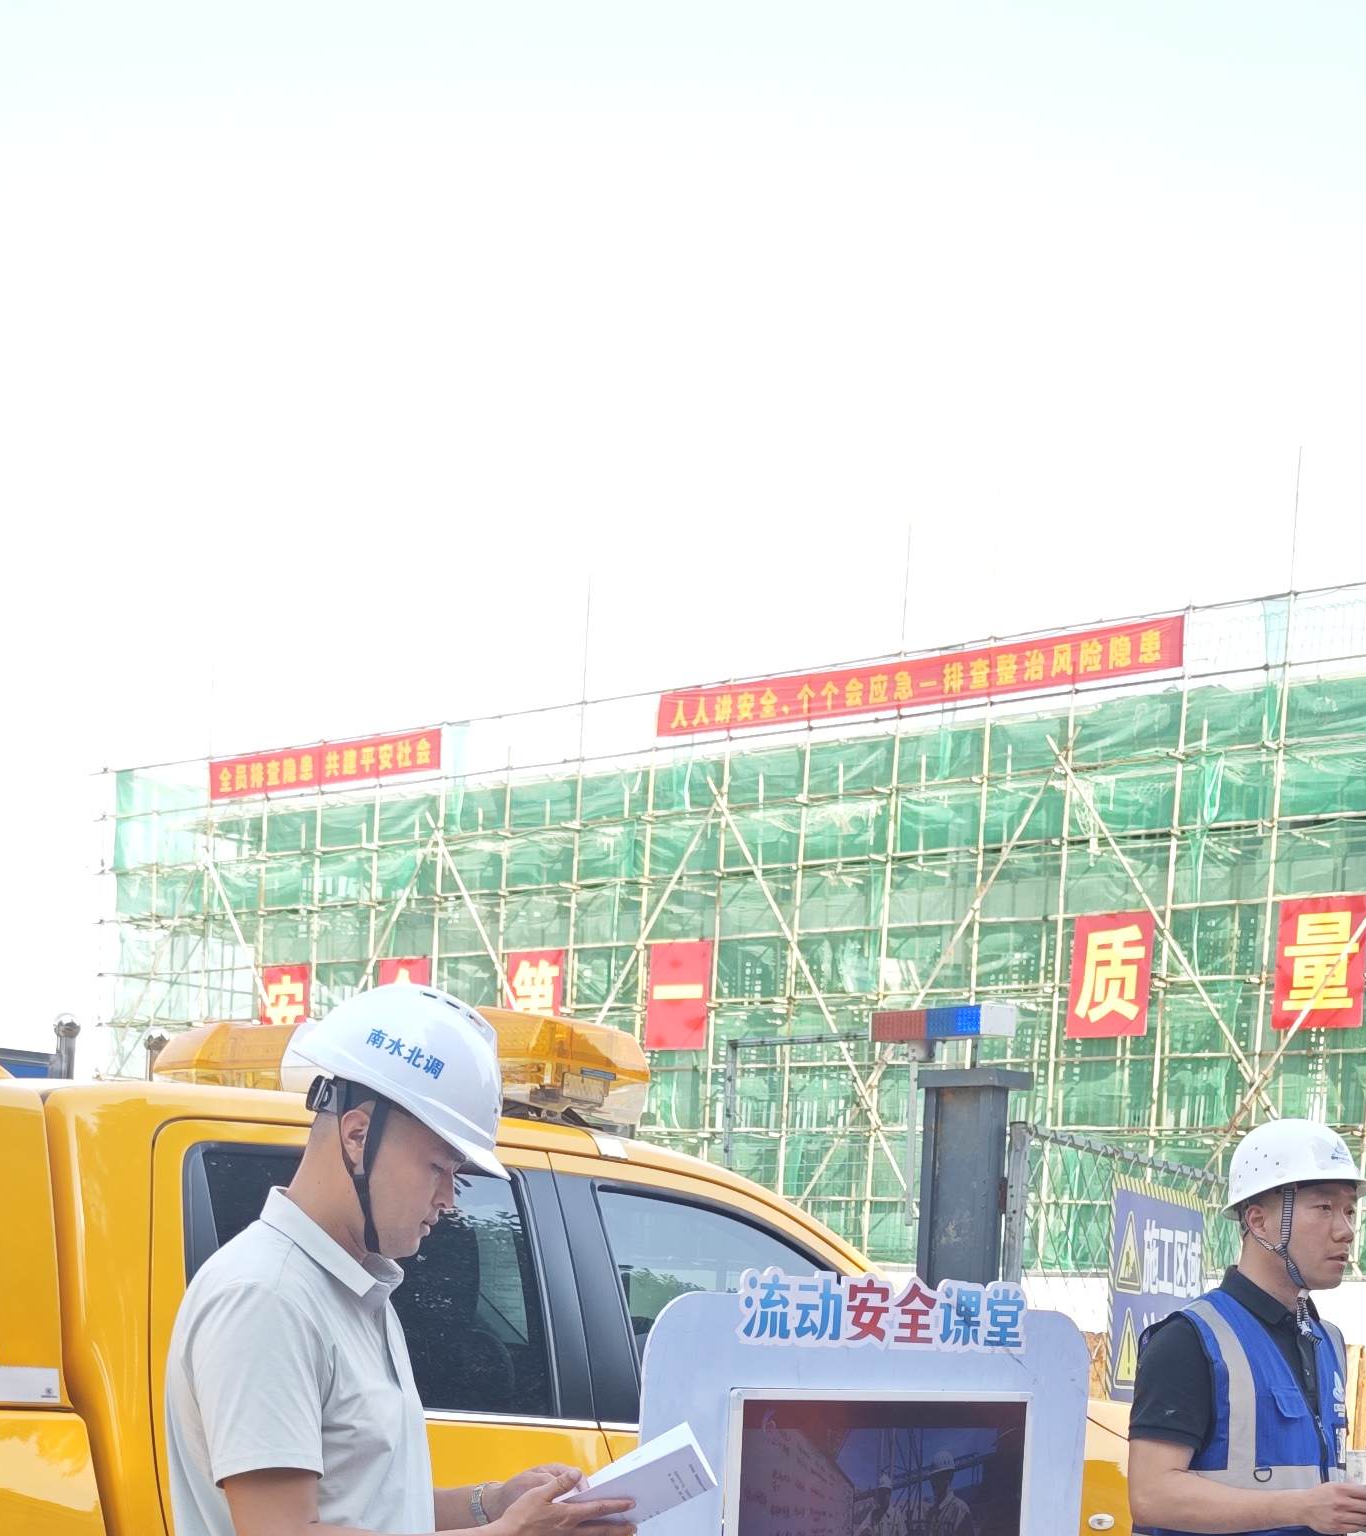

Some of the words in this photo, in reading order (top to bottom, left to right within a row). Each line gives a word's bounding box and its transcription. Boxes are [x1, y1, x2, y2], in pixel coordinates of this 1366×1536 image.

[325, 738, 432, 778] 共建平安社会
[365, 1028, 445, 1080] 南水北调
[1143, 1219, 1201, 1299] 施工区域
[742, 1276, 1026, 1348] 流动安全课堂
